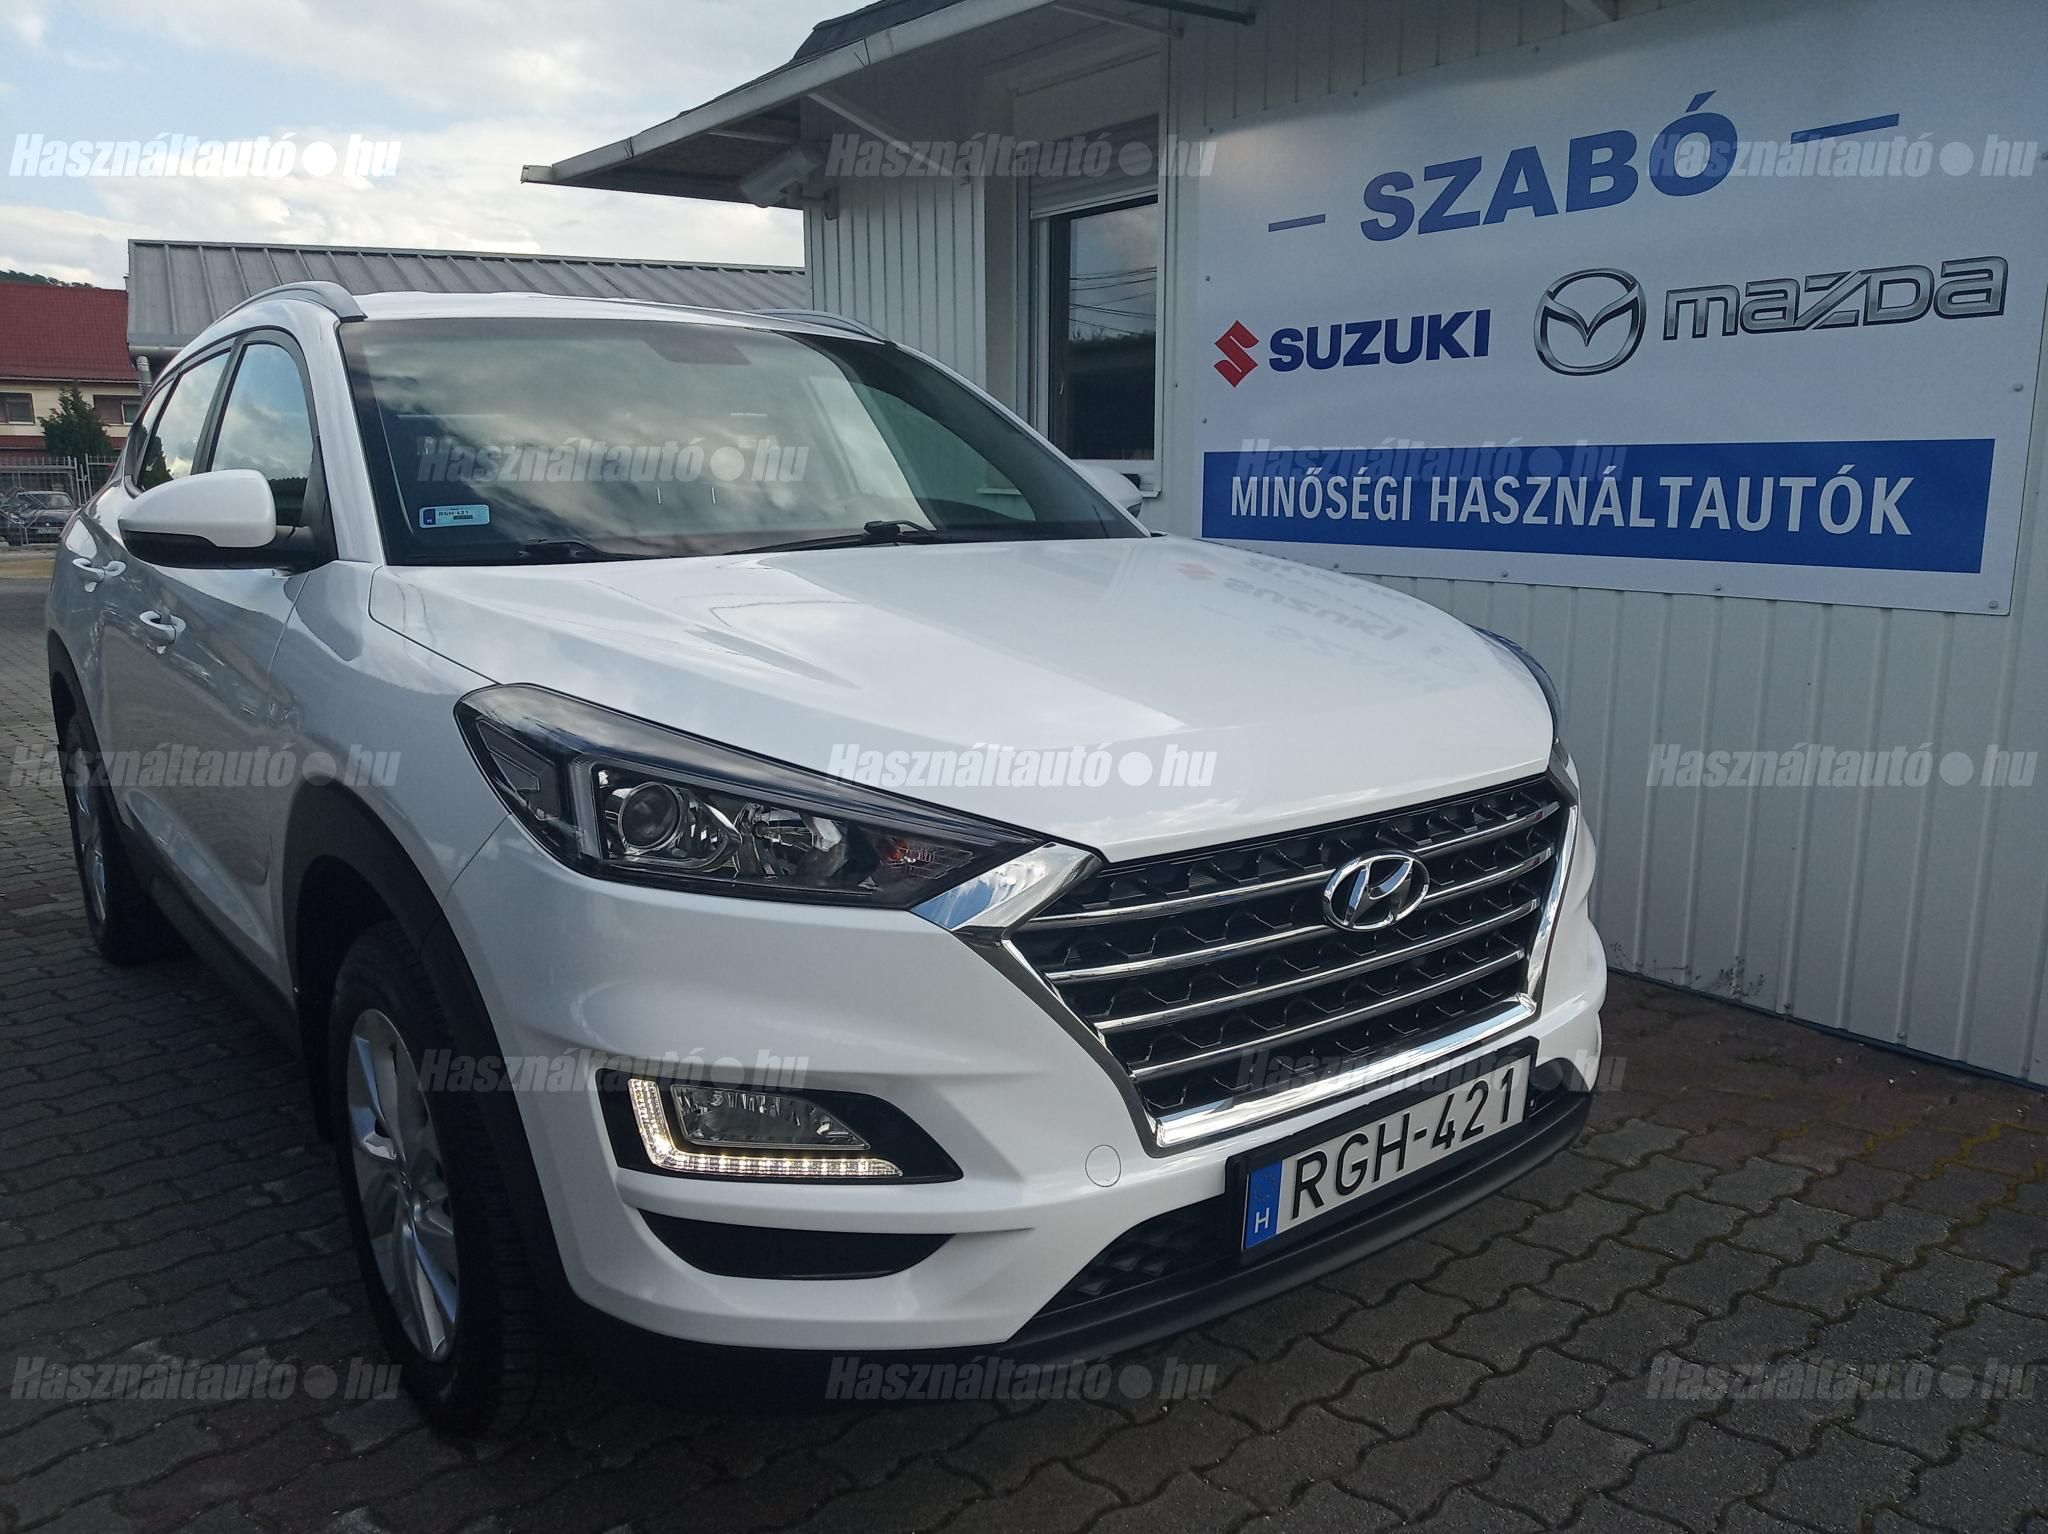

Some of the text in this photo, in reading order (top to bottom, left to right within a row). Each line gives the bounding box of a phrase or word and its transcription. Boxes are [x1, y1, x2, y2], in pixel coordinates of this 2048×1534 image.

[1360, 90, 1738, 242] SZABÓ
[1269, 309, 1491, 373] SUZUKI
[1230, 465, 1915, 537] MINŐSÉGI HASZNÁLTAUTÓK
[1290, 1067, 1516, 1220] RGH-421
[1253, 1206, 1270, 1234] H
